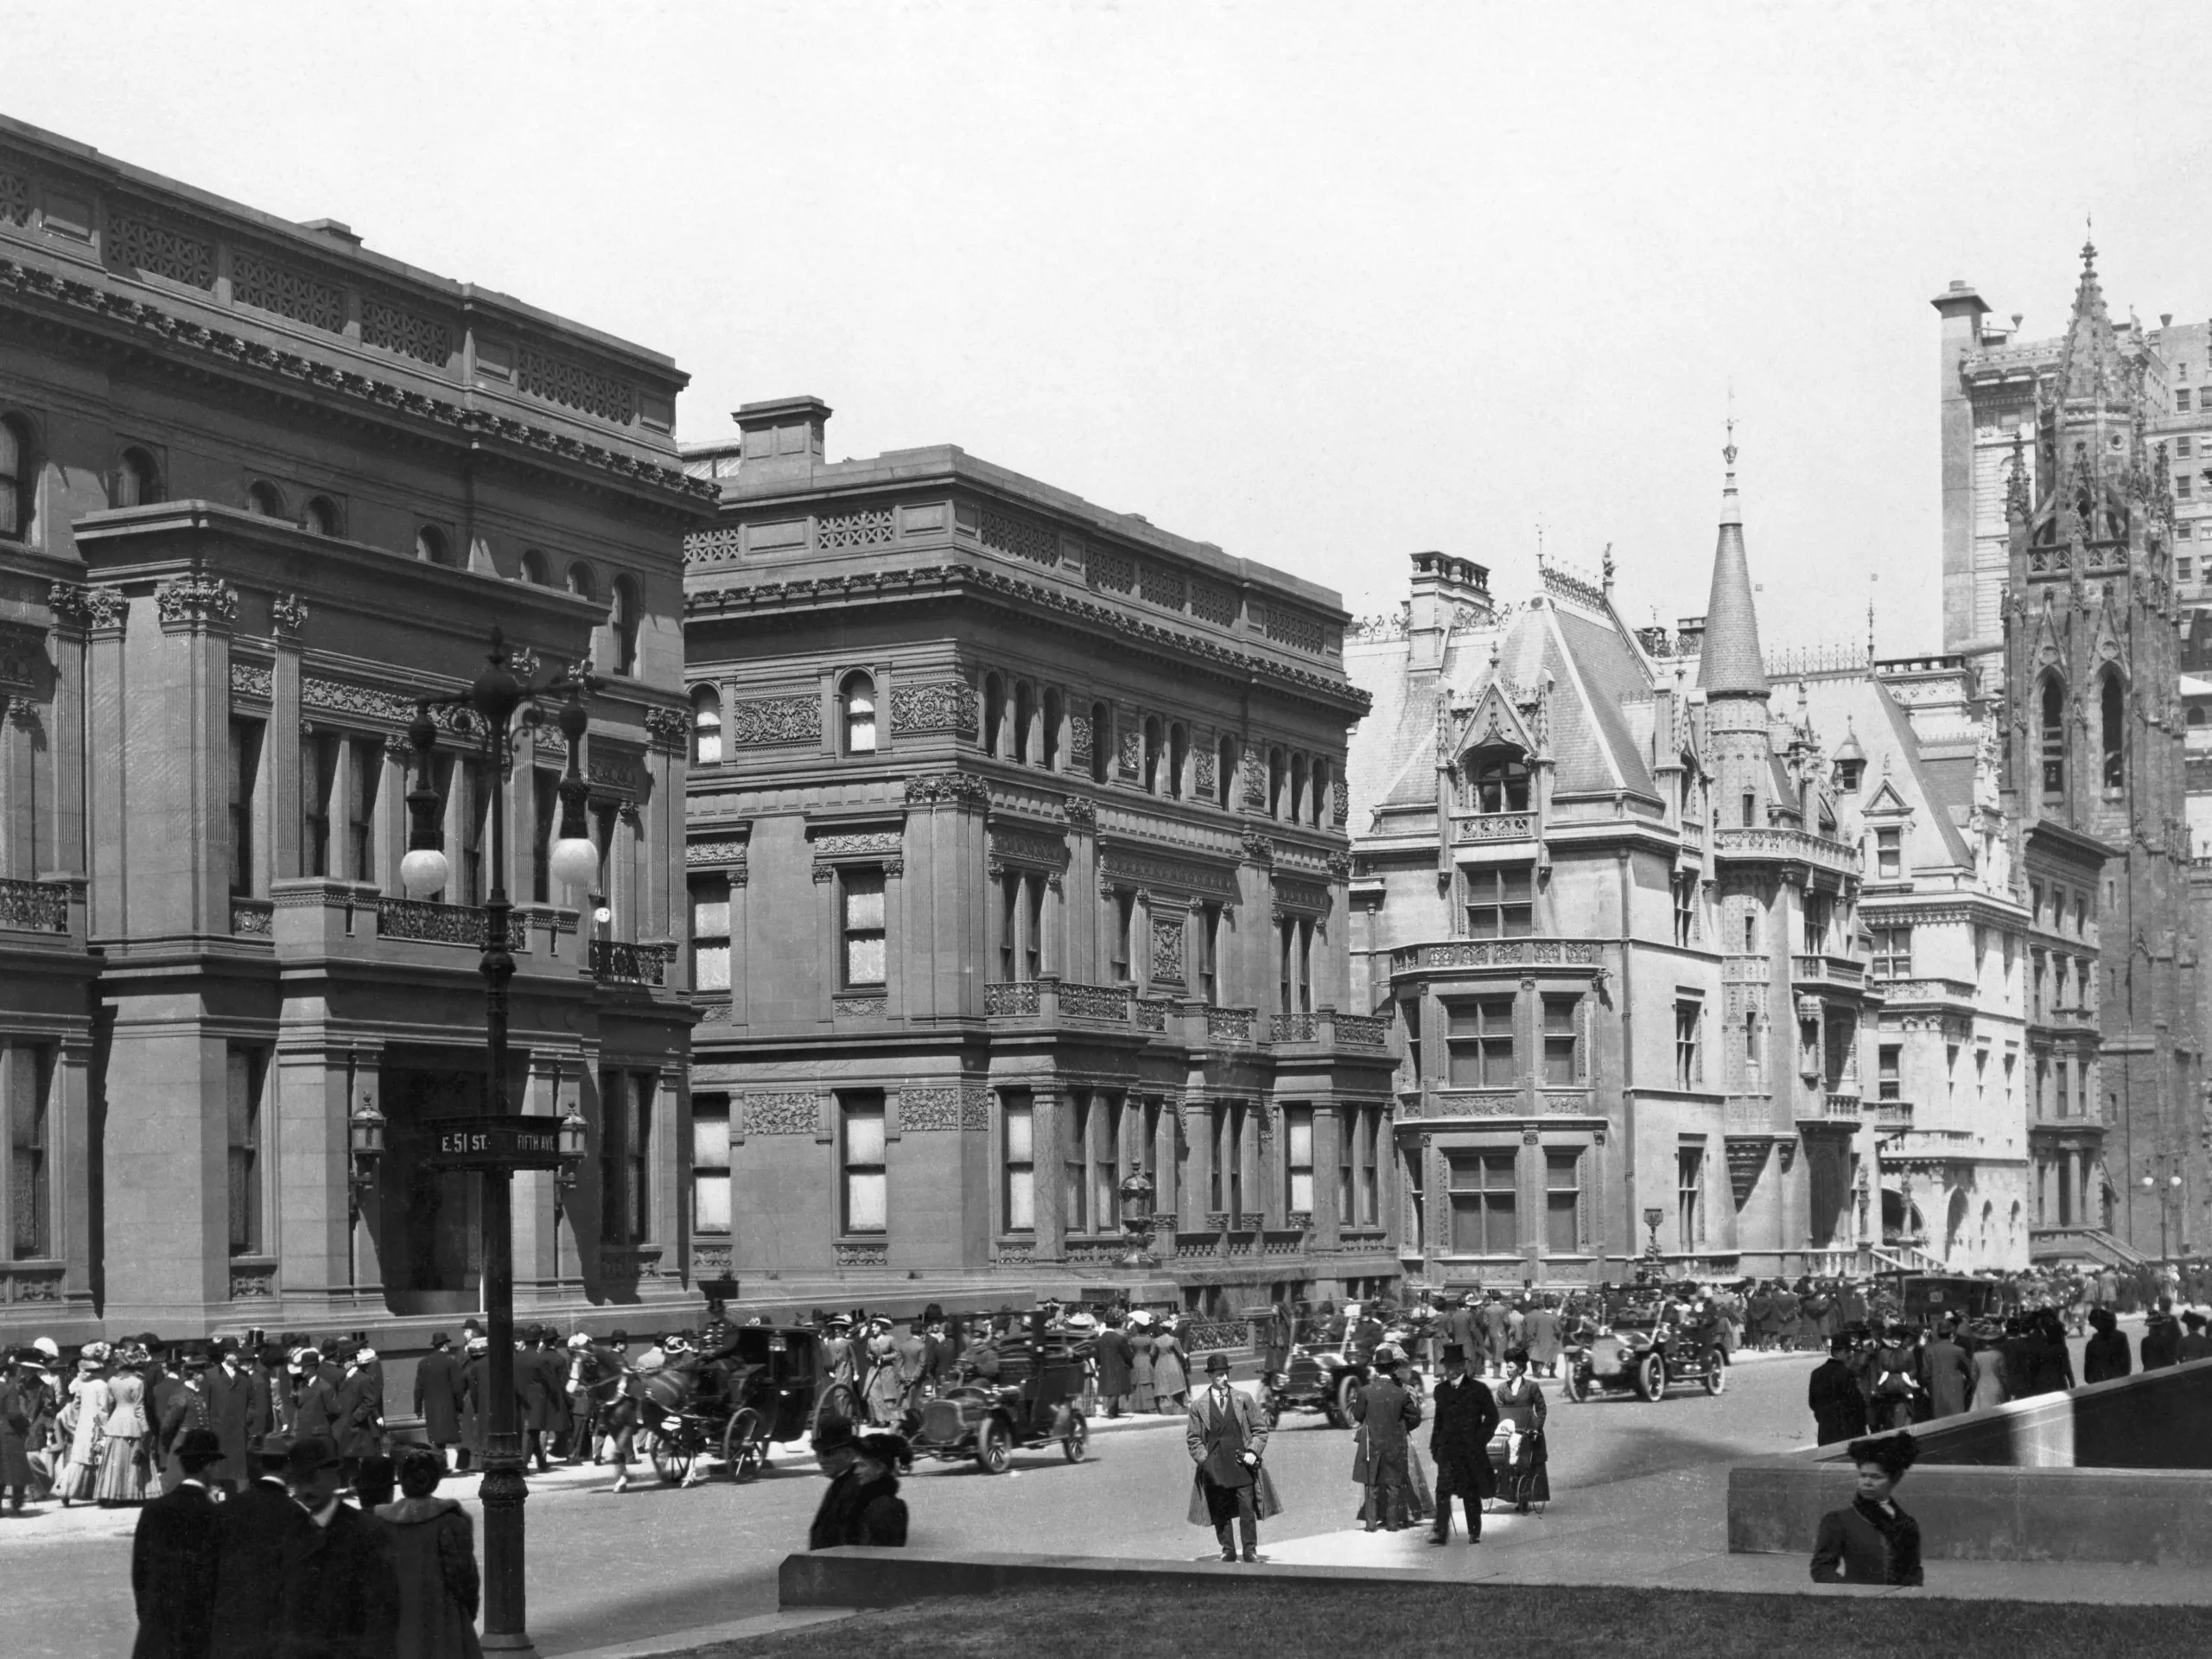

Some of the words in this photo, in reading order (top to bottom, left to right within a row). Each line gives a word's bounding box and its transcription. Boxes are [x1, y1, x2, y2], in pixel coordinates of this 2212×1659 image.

[454, 1133, 467, 1153] 51
[518, 1134, 539, 1151] FIFTH
[541, 1135, 554, 1151] AVE
